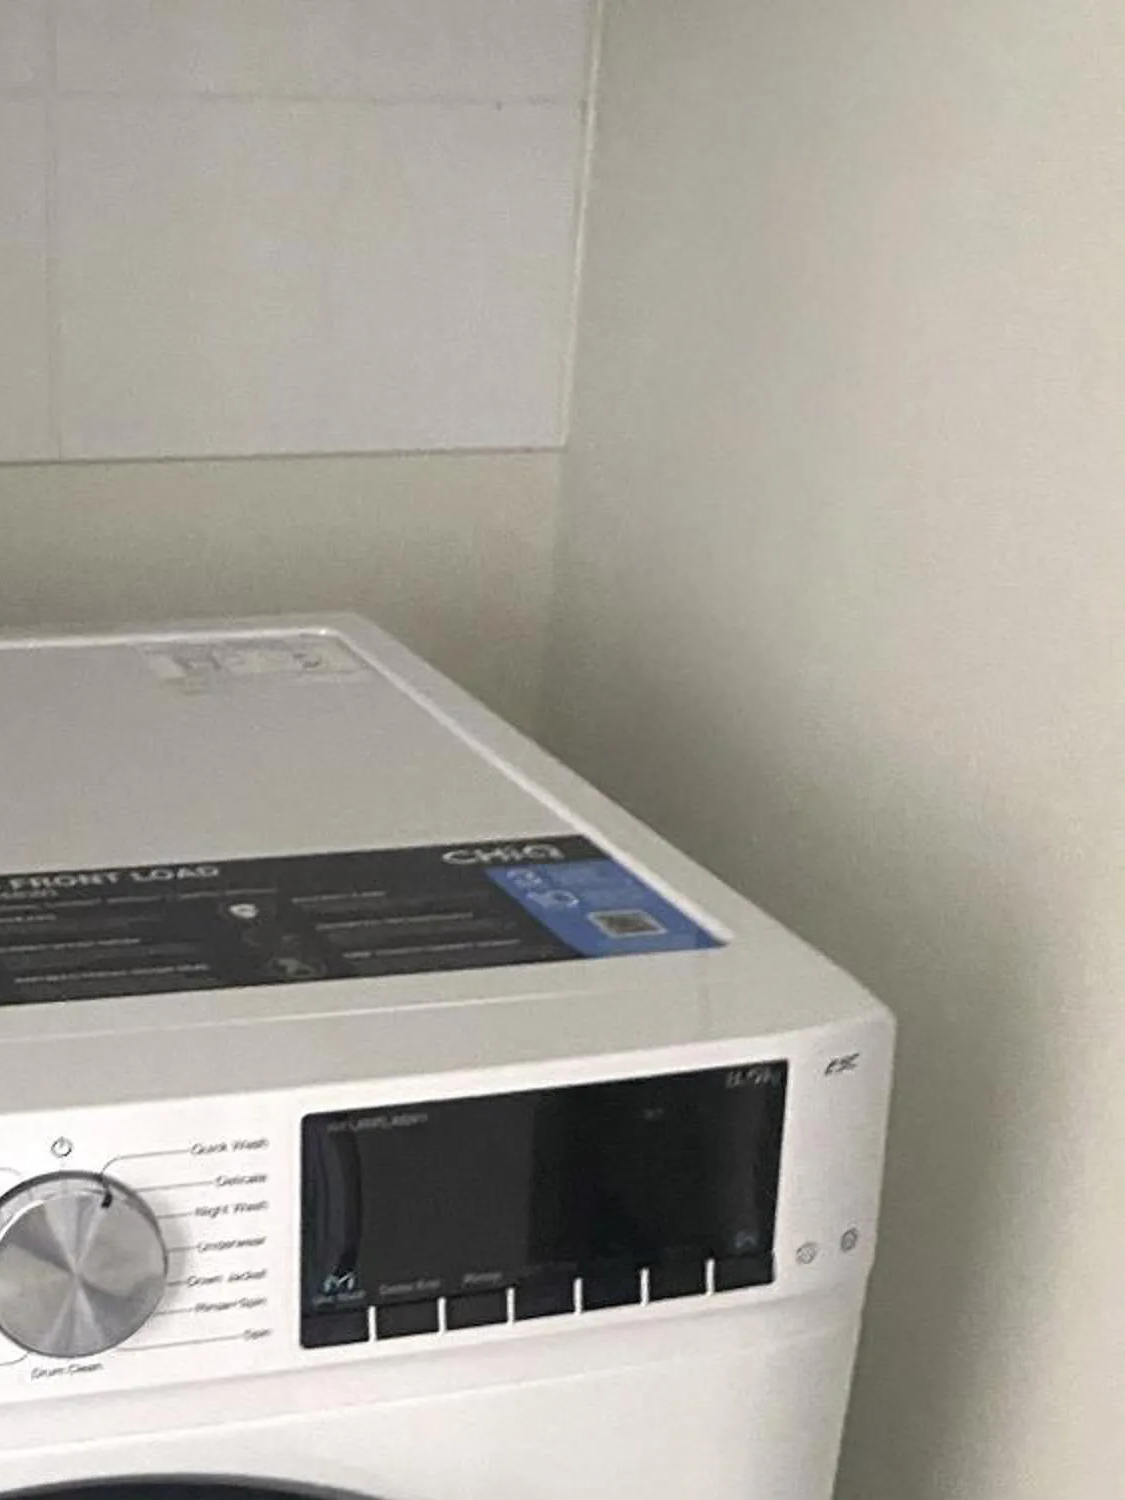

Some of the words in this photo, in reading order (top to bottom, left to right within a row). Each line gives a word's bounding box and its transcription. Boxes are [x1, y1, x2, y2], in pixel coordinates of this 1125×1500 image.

[441, 843, 565, 866] CHiQ
[9, 871, 119, 891] FRONT
[130, 866, 220, 882] LOAD
